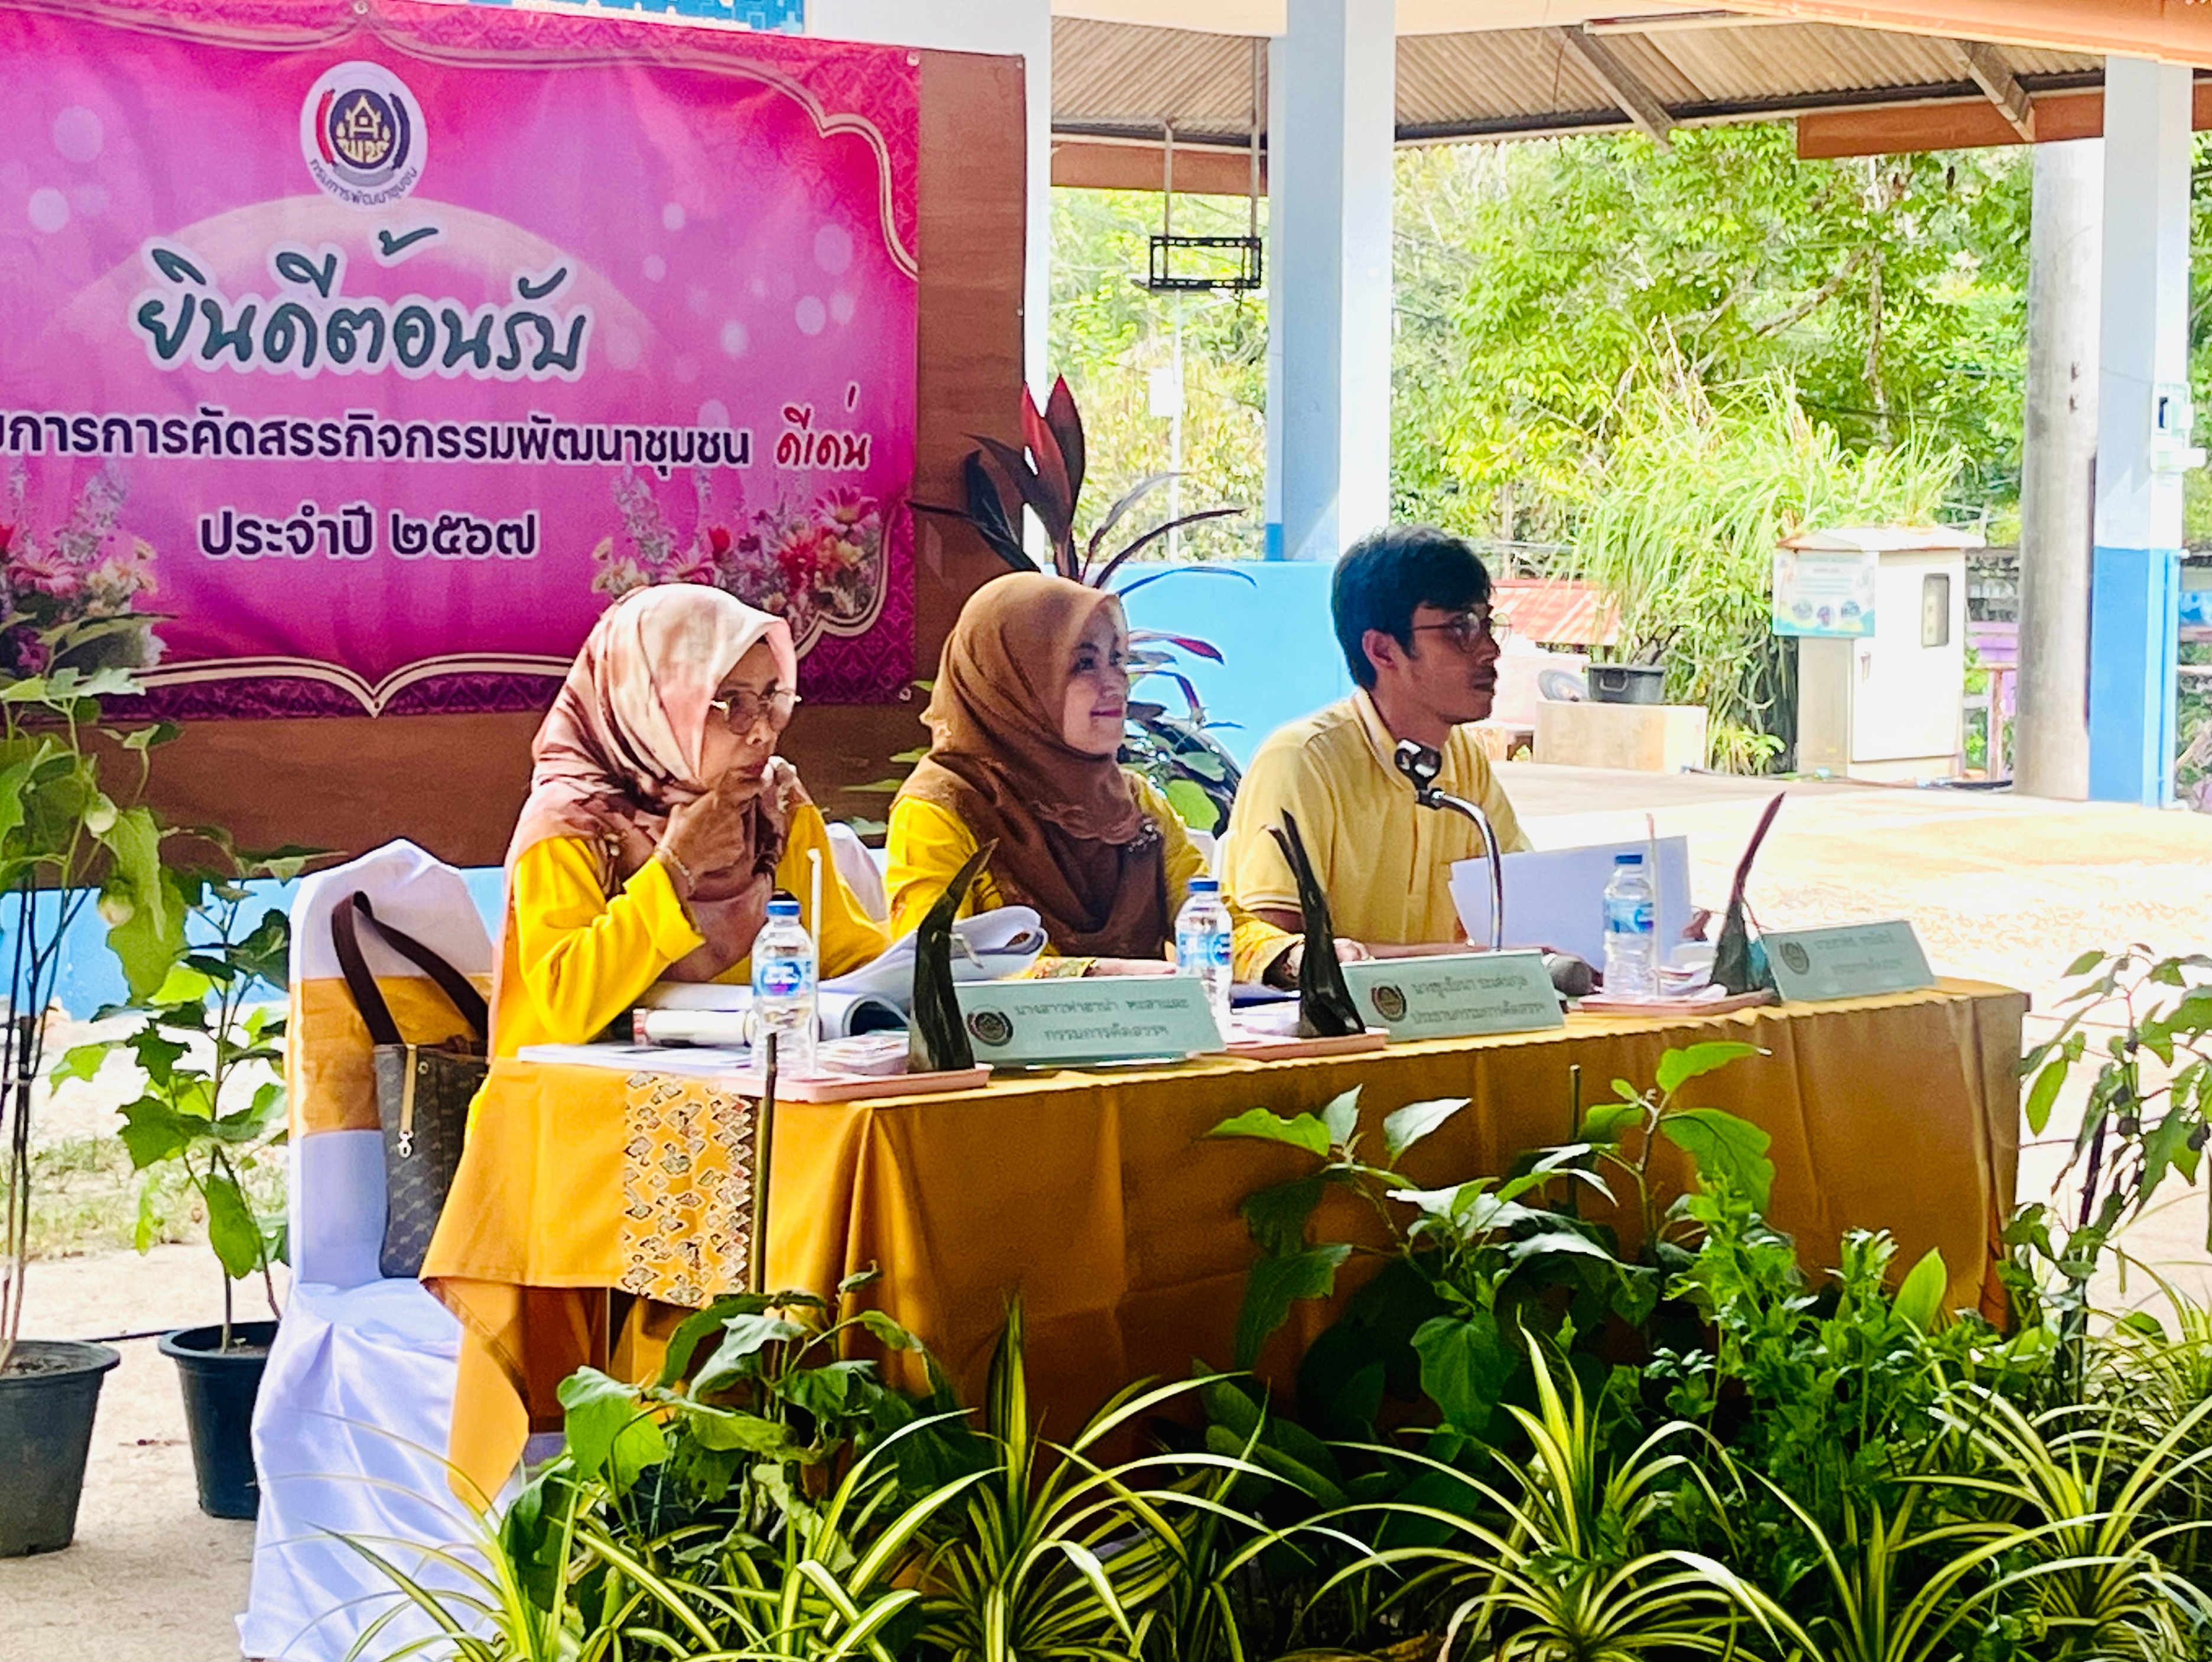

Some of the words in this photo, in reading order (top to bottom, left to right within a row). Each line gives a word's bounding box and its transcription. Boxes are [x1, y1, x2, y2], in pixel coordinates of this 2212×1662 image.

[310, 159, 417, 205] กรมการพัฒนาชุมชน
[138, 227, 586, 371] ยินดีต้อนรับ
[0, 407, 749, 475] การการคัดสรรกิจกรรมพัฒนาชุมชน
[777, 385, 868, 468] ดีเด่น
[202, 505, 372, 554] ประจำปี
[392, 513, 535, 554] ๒๕๖๗
